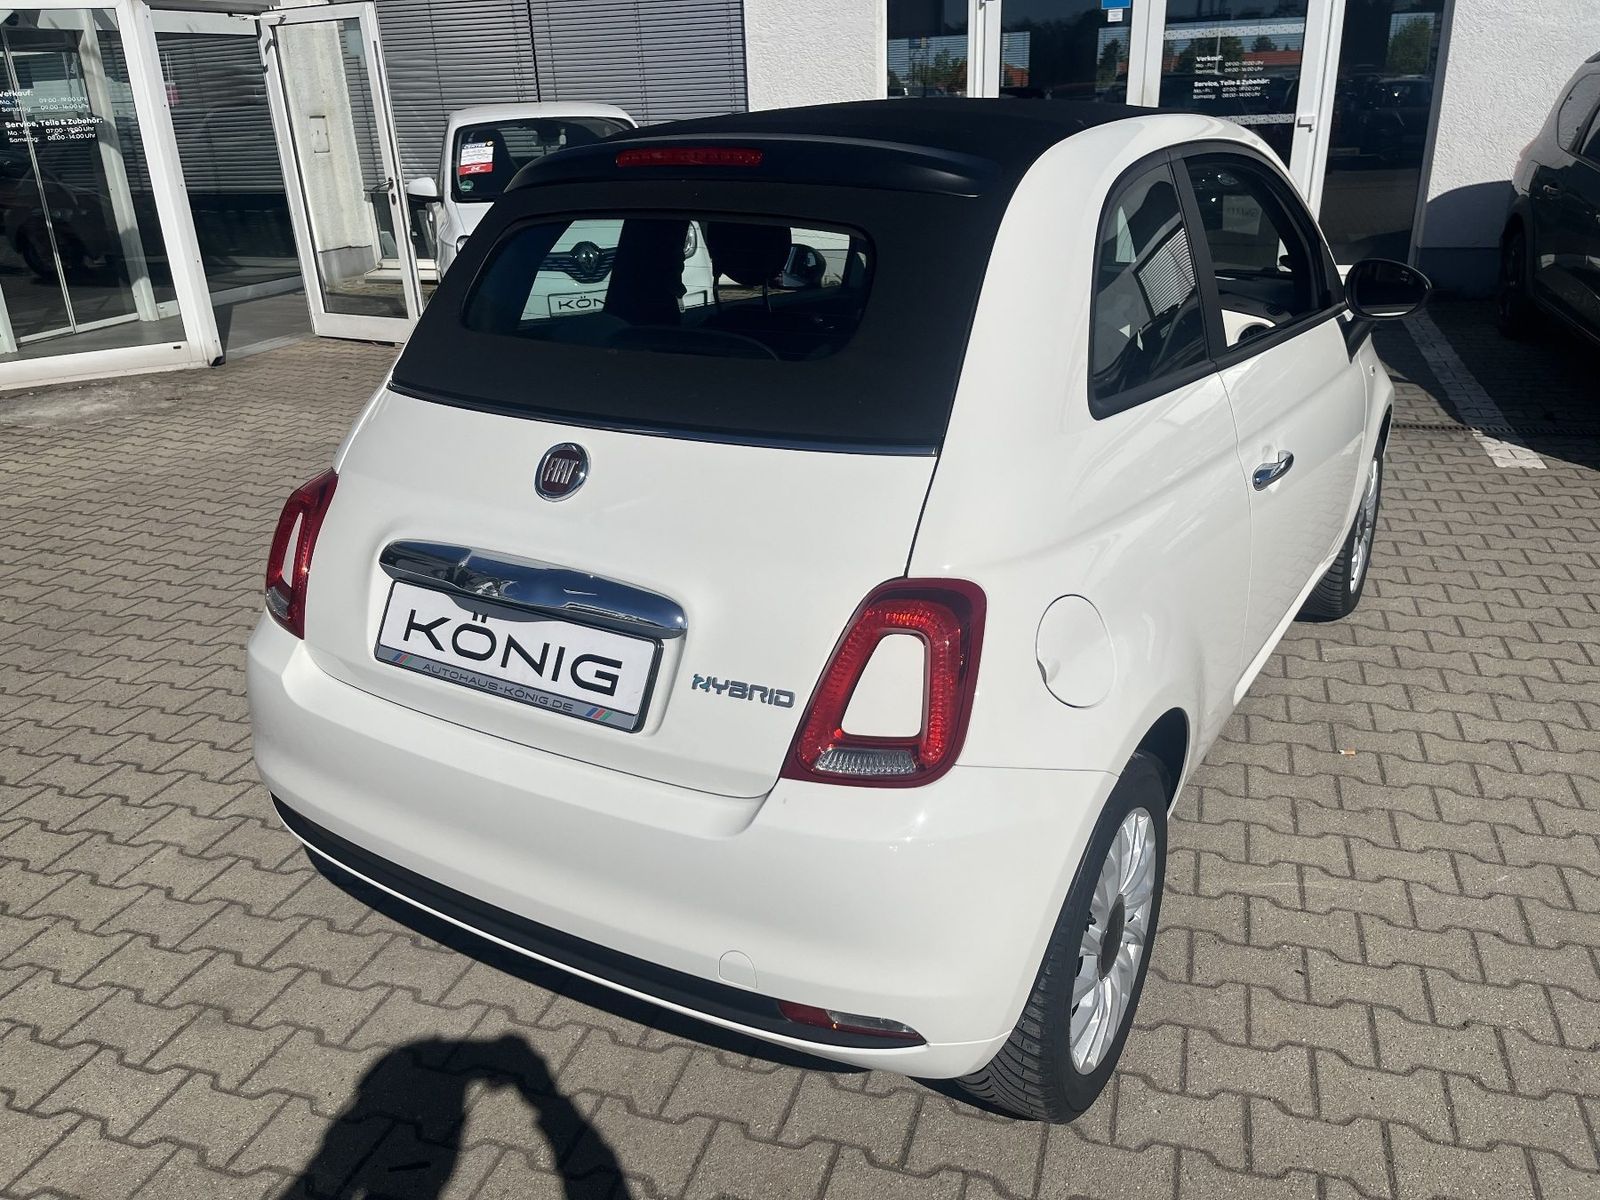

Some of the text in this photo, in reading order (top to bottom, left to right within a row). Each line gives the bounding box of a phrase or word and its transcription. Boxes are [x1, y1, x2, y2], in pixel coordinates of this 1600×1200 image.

[67, 117, 103, 125] Zubehör:
[543, 457, 579, 485] FIAT
[402, 609, 623, 697] KÖNIG
[422, 662, 574, 712] AUTOHAUS-KÖNIG.DE
[691, 673, 796, 709] HYBRID
